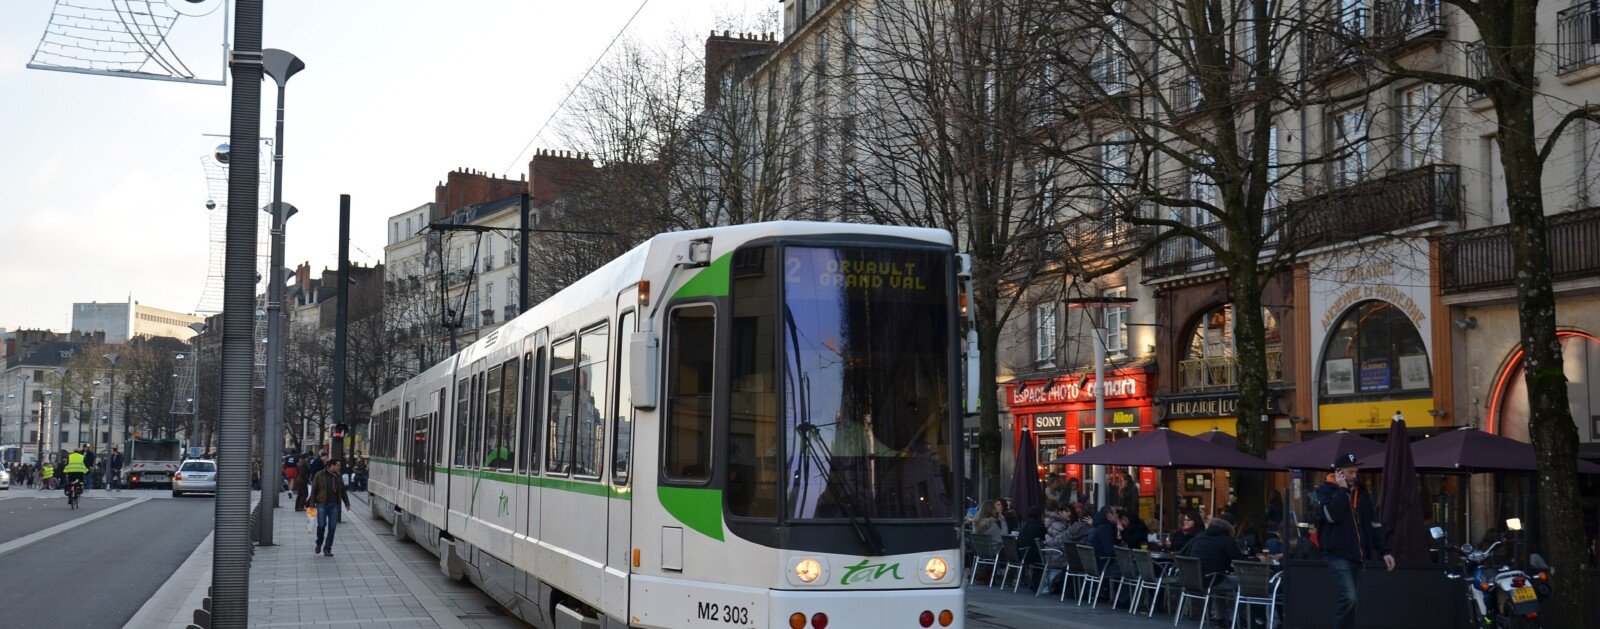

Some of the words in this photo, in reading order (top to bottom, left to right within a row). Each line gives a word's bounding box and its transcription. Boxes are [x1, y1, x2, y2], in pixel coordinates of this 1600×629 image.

[786, 258, 802, 284] 2
[826, 260, 916, 276] ORVAULT
[820, 274, 880, 289] GRAND
[890, 276, 926, 291] VAL
[1321, 287, 1362, 331] ANCIENNE
[1375, 284, 1426, 329] MODERNE
[1013, 387, 1046, 403] ESPACE
[1048, 383, 1079, 401] PHOTO
[1171, 399, 1217, 416] LIBRAIRIE
[1036, 416, 1062, 427] SONY
[1113, 412, 1134, 424] Nikon
[841, 559, 904, 586] tan
[698, 602, 718, 621] M2
[723, 606, 748, 625] 303
